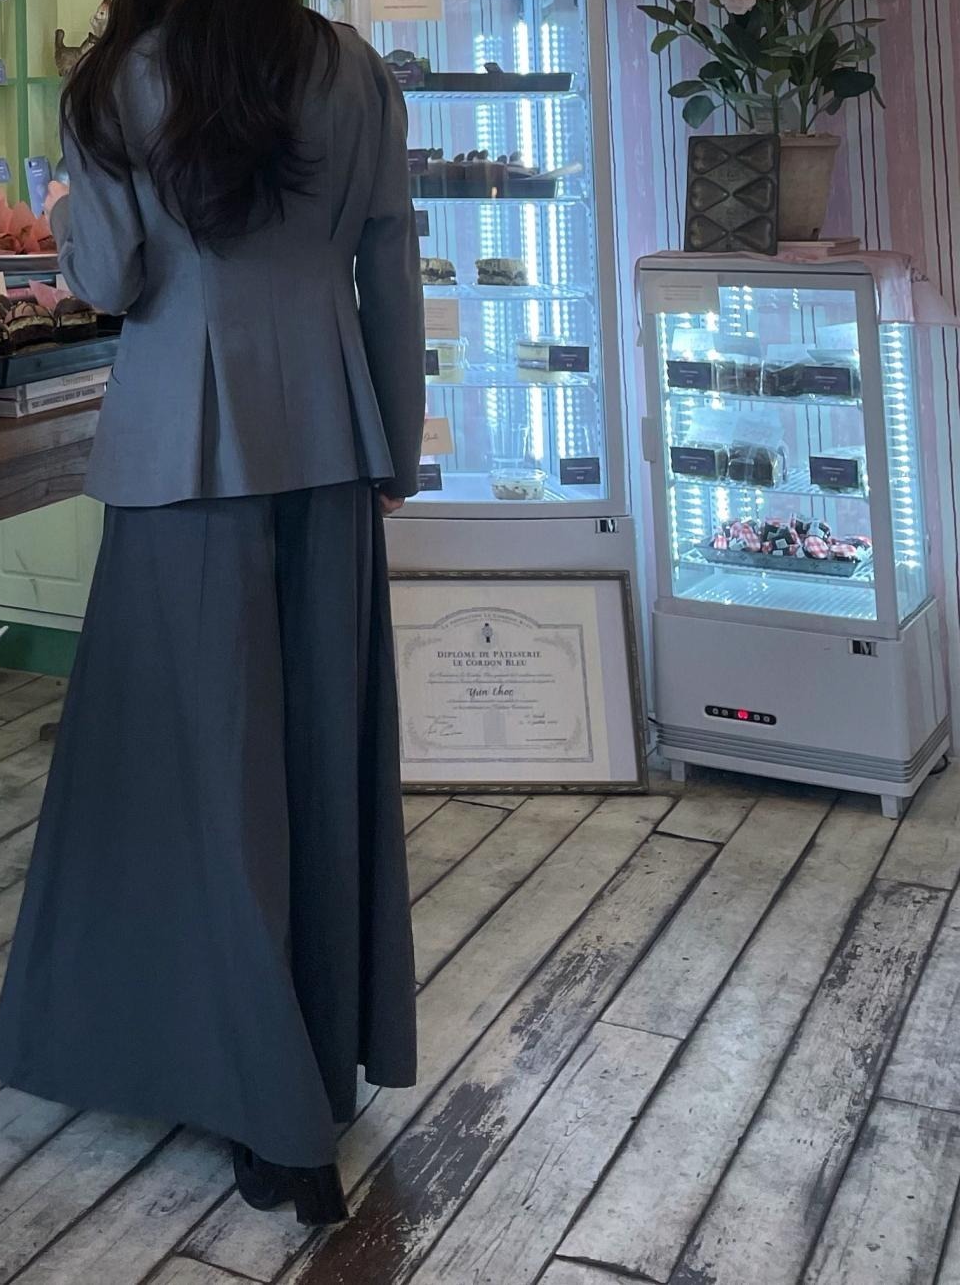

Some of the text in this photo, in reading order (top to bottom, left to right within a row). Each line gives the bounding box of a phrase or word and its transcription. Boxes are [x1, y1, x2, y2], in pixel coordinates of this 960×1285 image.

[453, 659, 527, 667] LE CORDON BLEU
